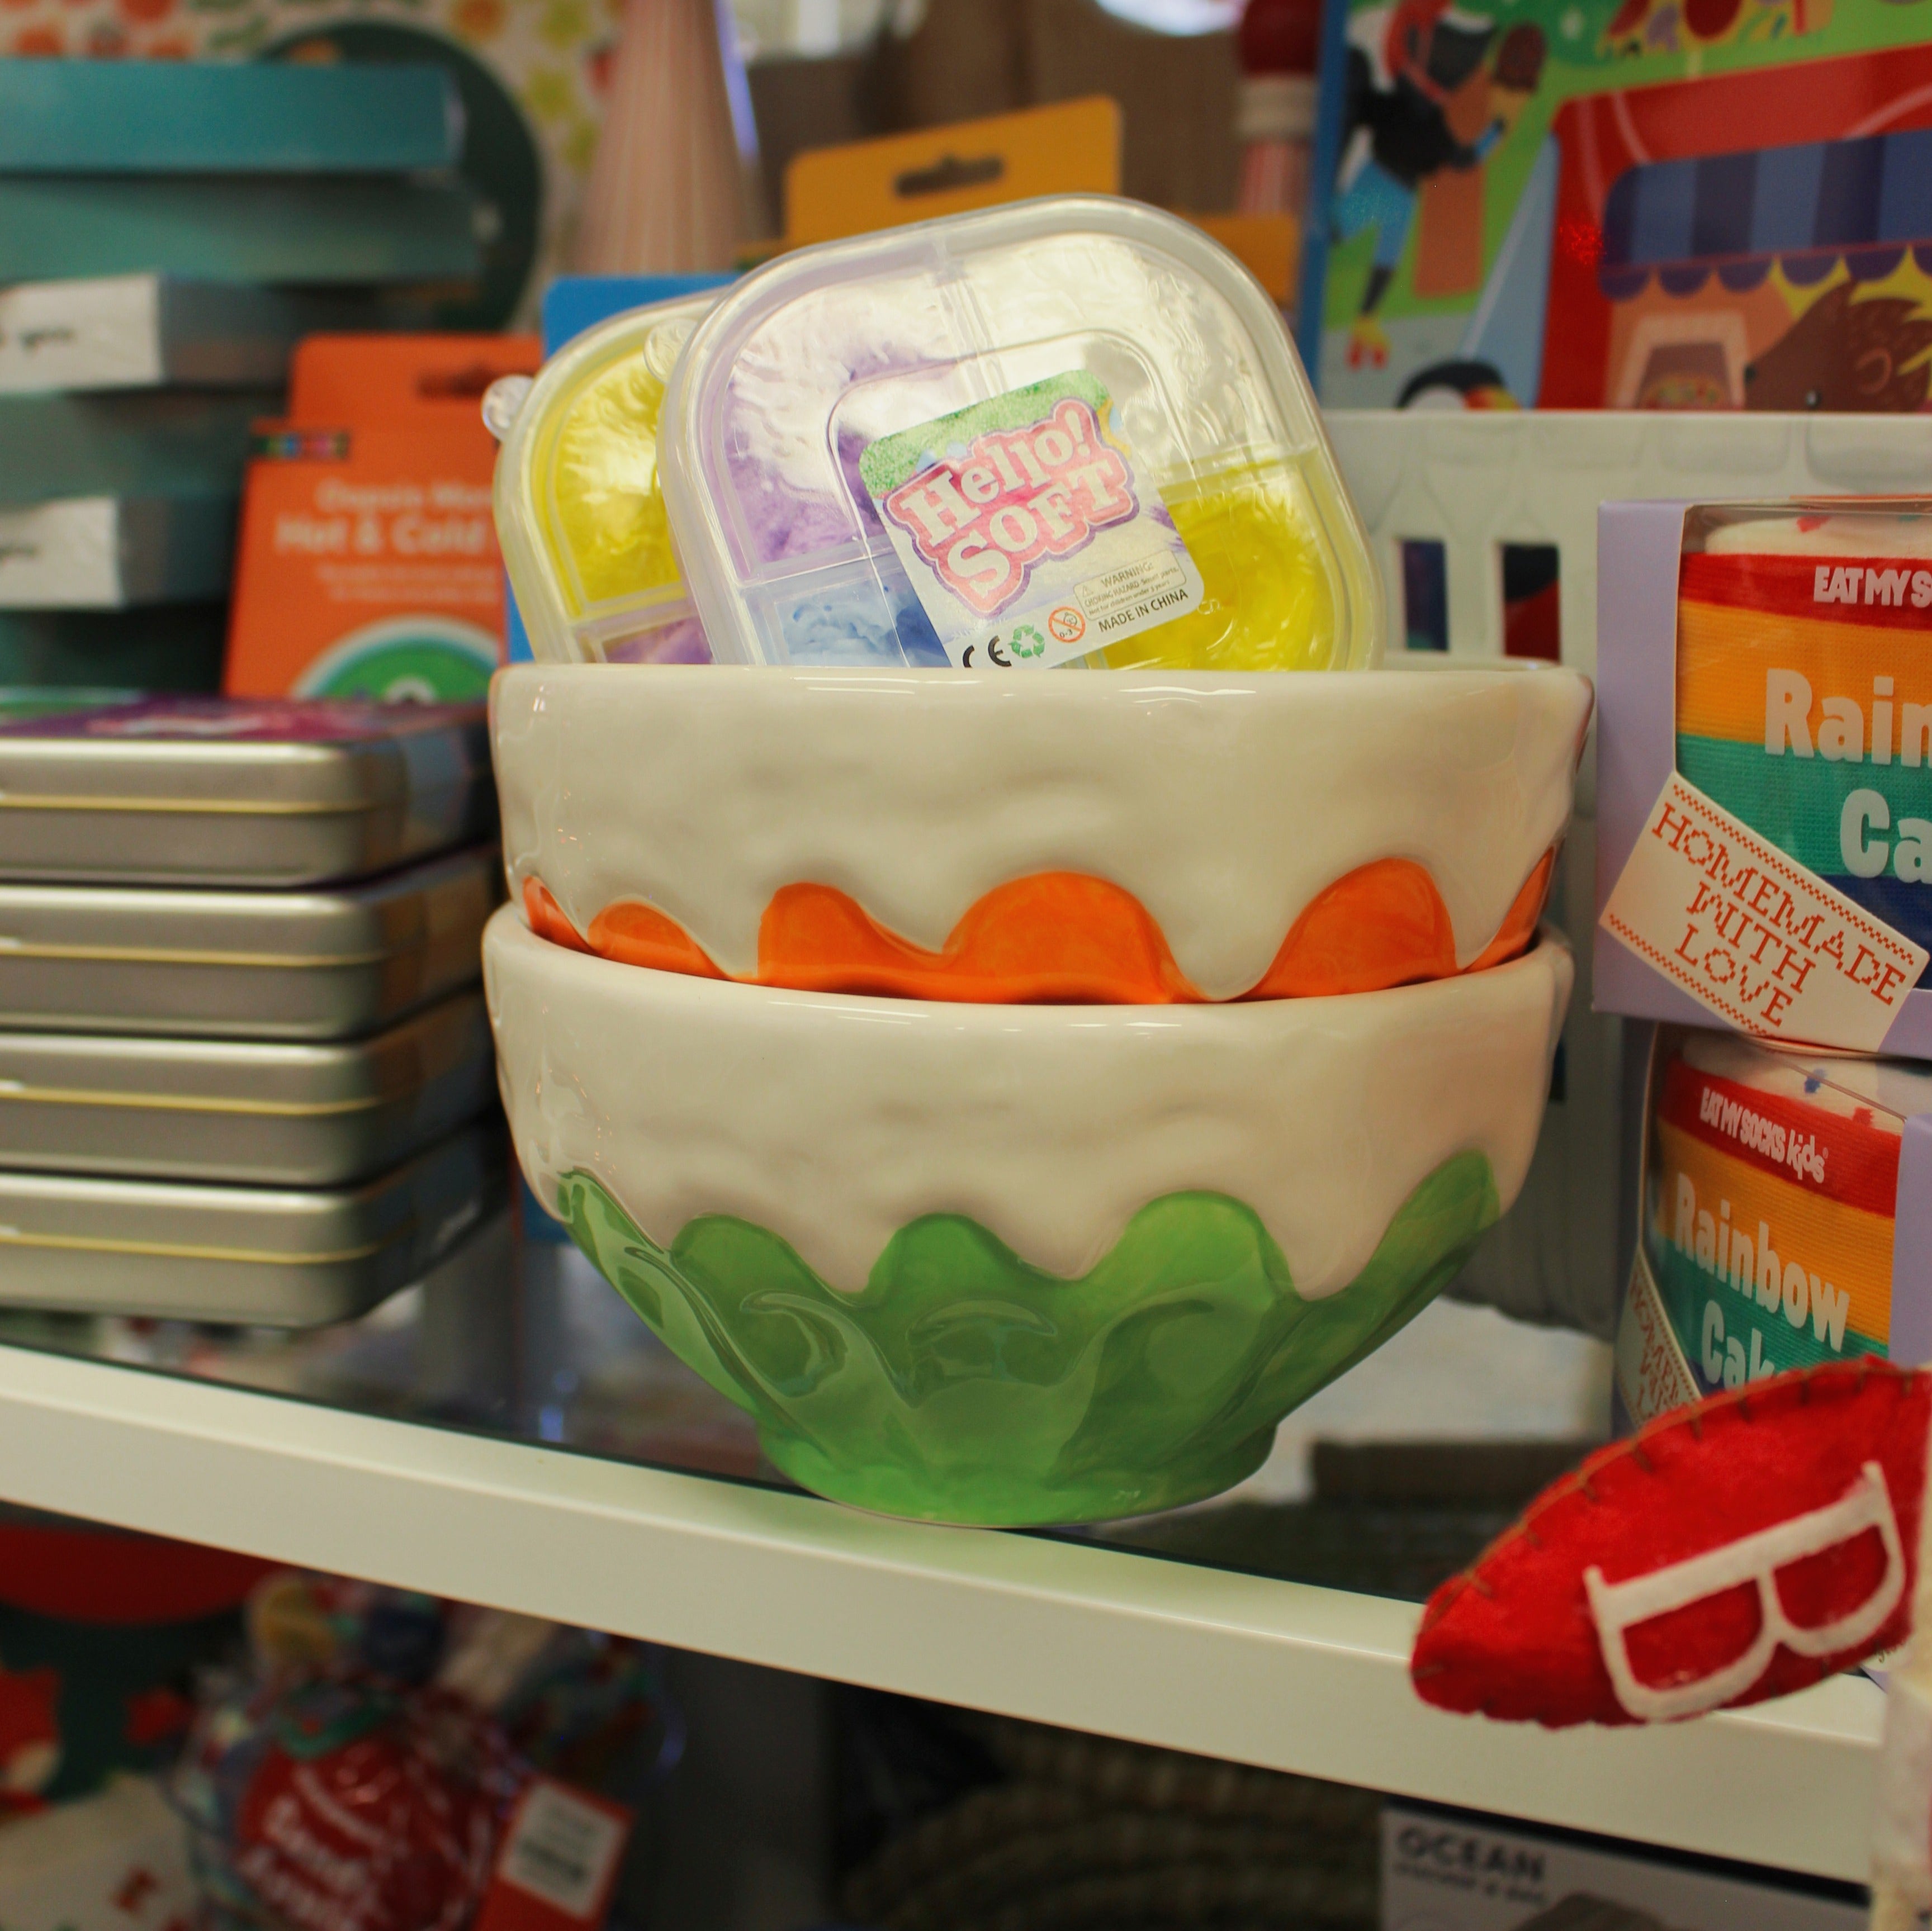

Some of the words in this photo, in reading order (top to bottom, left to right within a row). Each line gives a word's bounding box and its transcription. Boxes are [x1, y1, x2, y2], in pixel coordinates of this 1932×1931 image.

[899, 409, 1091, 546] Hello!
[948, 459, 1118, 599] SOFT
[1059, 629, 1073, 638] 0-3
[1085, 590, 1114, 608] CHOKING
[1098, 609, 1135, 632] MADE
[1135, 604, 1149, 618] IN
[1150, 589, 1188, 611] CHINA
[1813, 565, 1864, 604] EAT
[1864, 568, 1912, 607] MY
[1652, 803, 1906, 1006] HOMEMADE
[1685, 880, 1817, 994] WITH
[1675, 923, 1793, 1027] LOVE
[1699, 1085, 1723, 1128] EAT
[1720, 1097, 1743, 1138] MY
[1740, 1108, 1786, 1163] SOCKS
[1675, 1173, 1850, 1353] Rainbow
[1702, 1299, 1775, 1390] Cak
[1583, 1459, 1905, 1721] B
